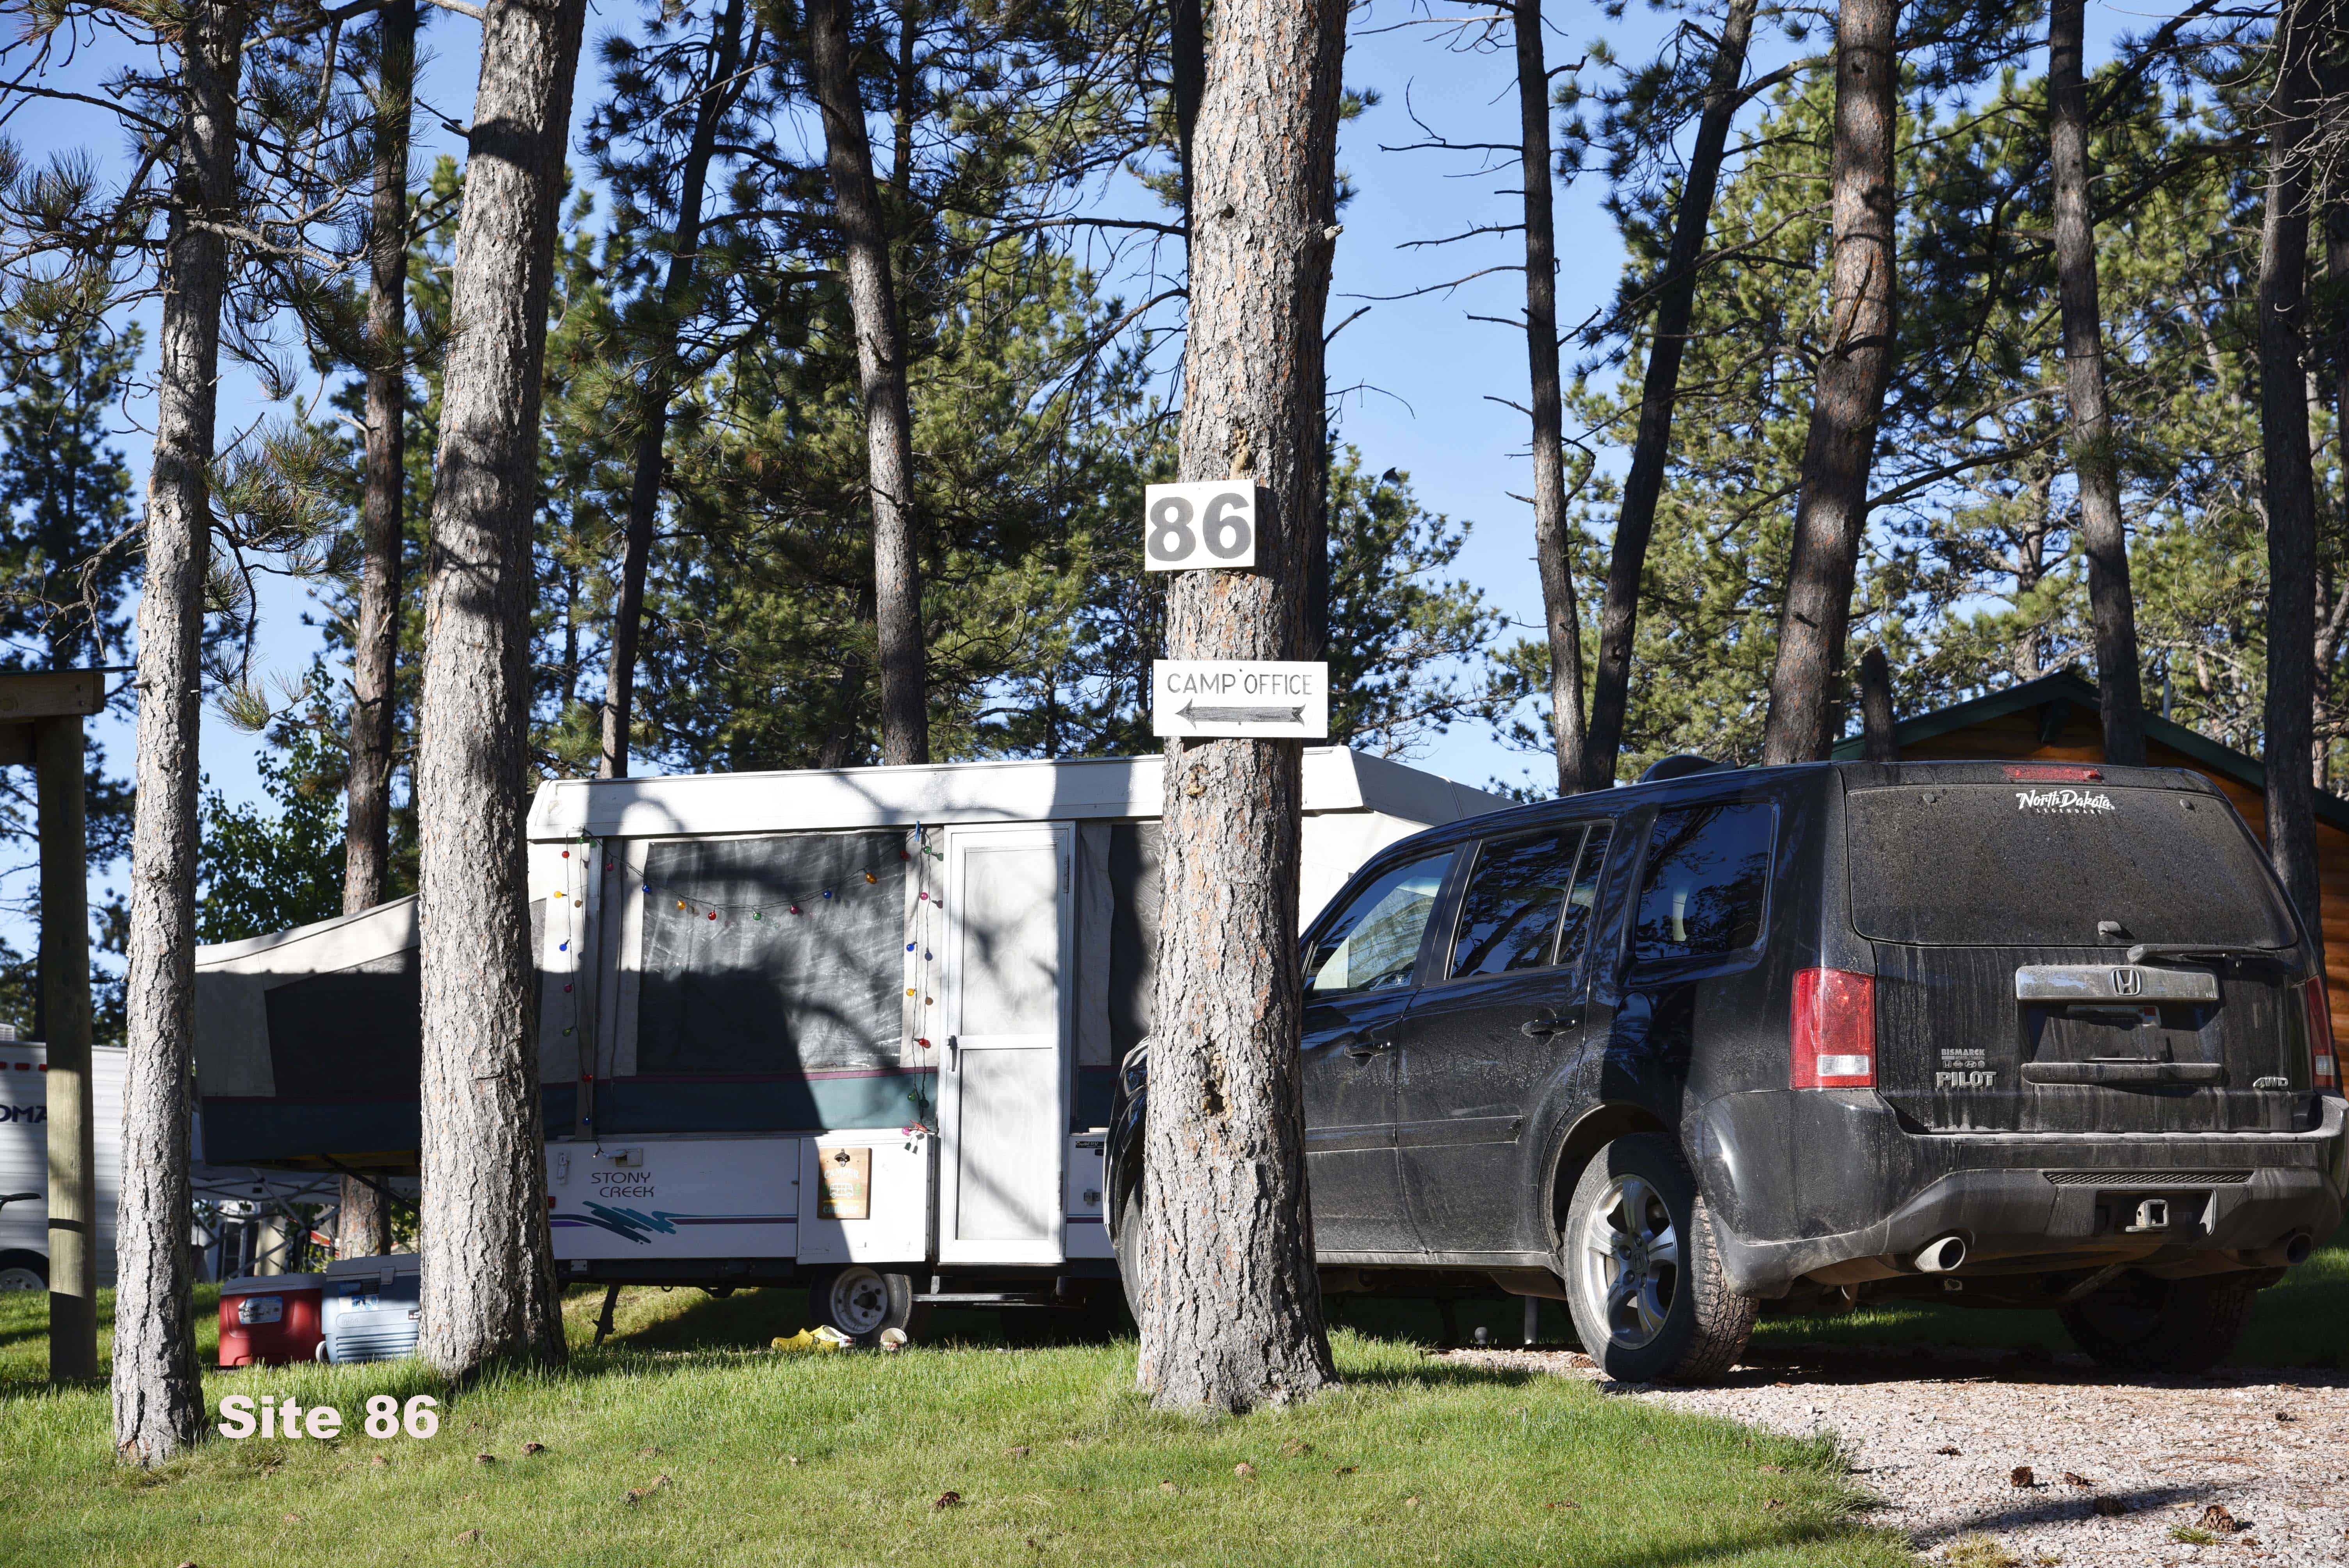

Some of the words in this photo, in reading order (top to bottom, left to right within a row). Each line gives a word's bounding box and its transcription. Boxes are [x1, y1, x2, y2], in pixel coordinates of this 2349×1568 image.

[1147, 493, 1252, 561] 86
[1167, 673, 1236, 694] CAMP
[1244, 674, 1312, 695] OFFICE
[2016, 789, 2060, 809] North
[2059, 789, 2112, 810] Dakota
[1936, 1071, 1997, 1087] PILOT
[2253, 1076, 2288, 1088] 4WD
[591, 1172, 651, 1184] STONY
[599, 1186, 655, 1197] CREEK
